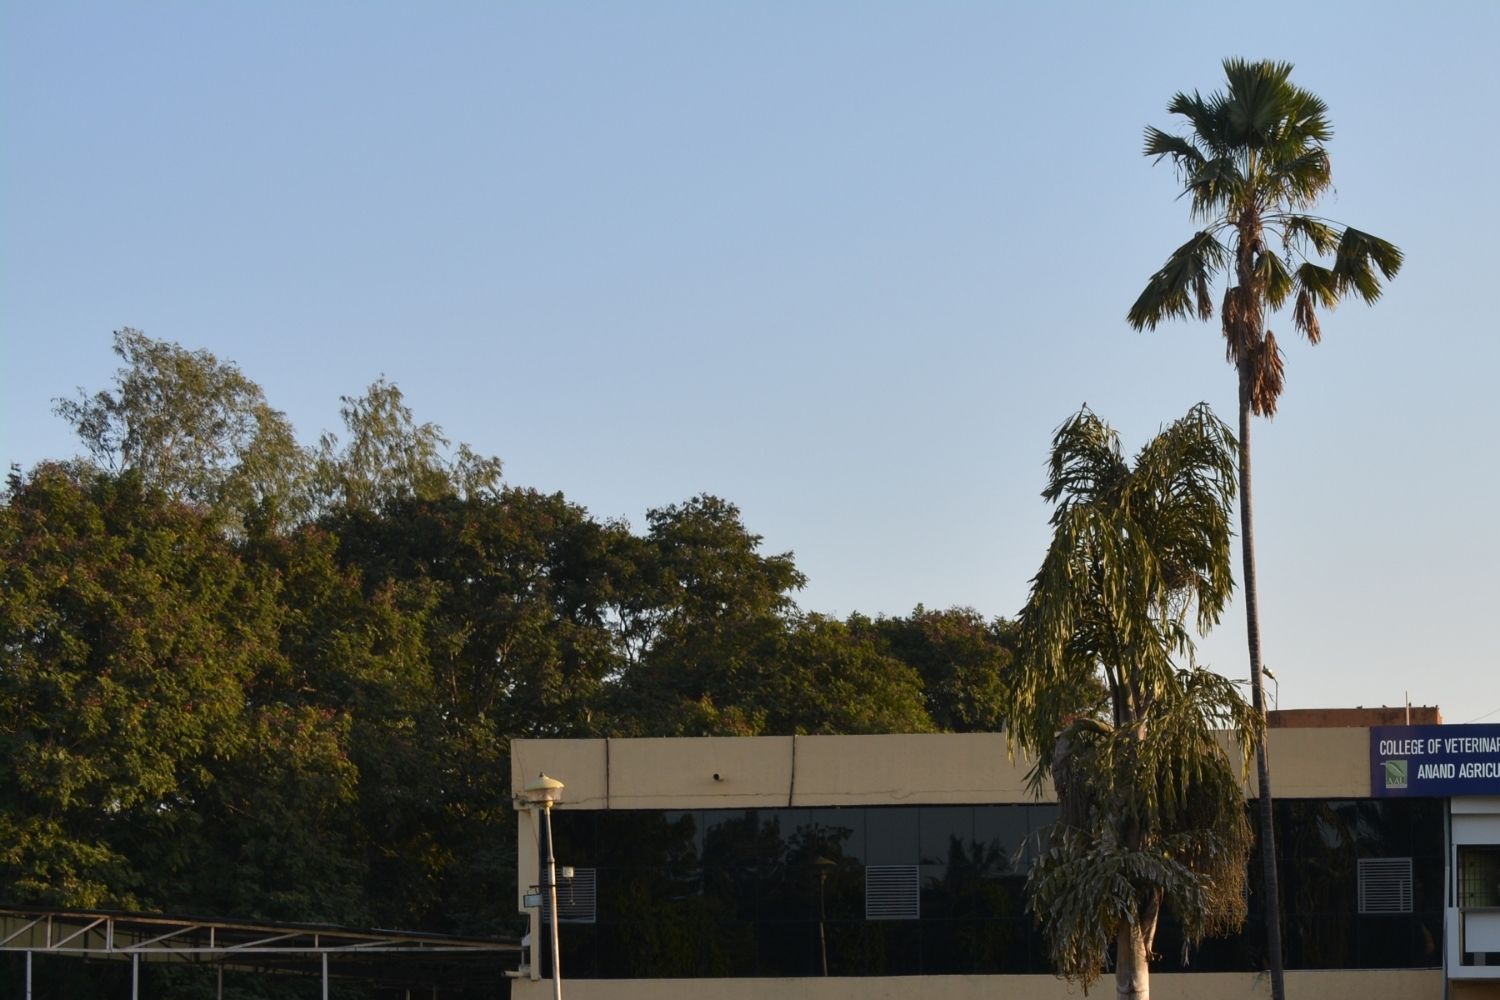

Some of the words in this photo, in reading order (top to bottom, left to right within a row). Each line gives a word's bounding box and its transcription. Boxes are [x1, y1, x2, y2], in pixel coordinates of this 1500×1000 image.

[1379, 739, 1424, 755] COLLEGE
[1428, 738, 1442, 754] OF
[1417, 763, 1456, 779] ANAND
